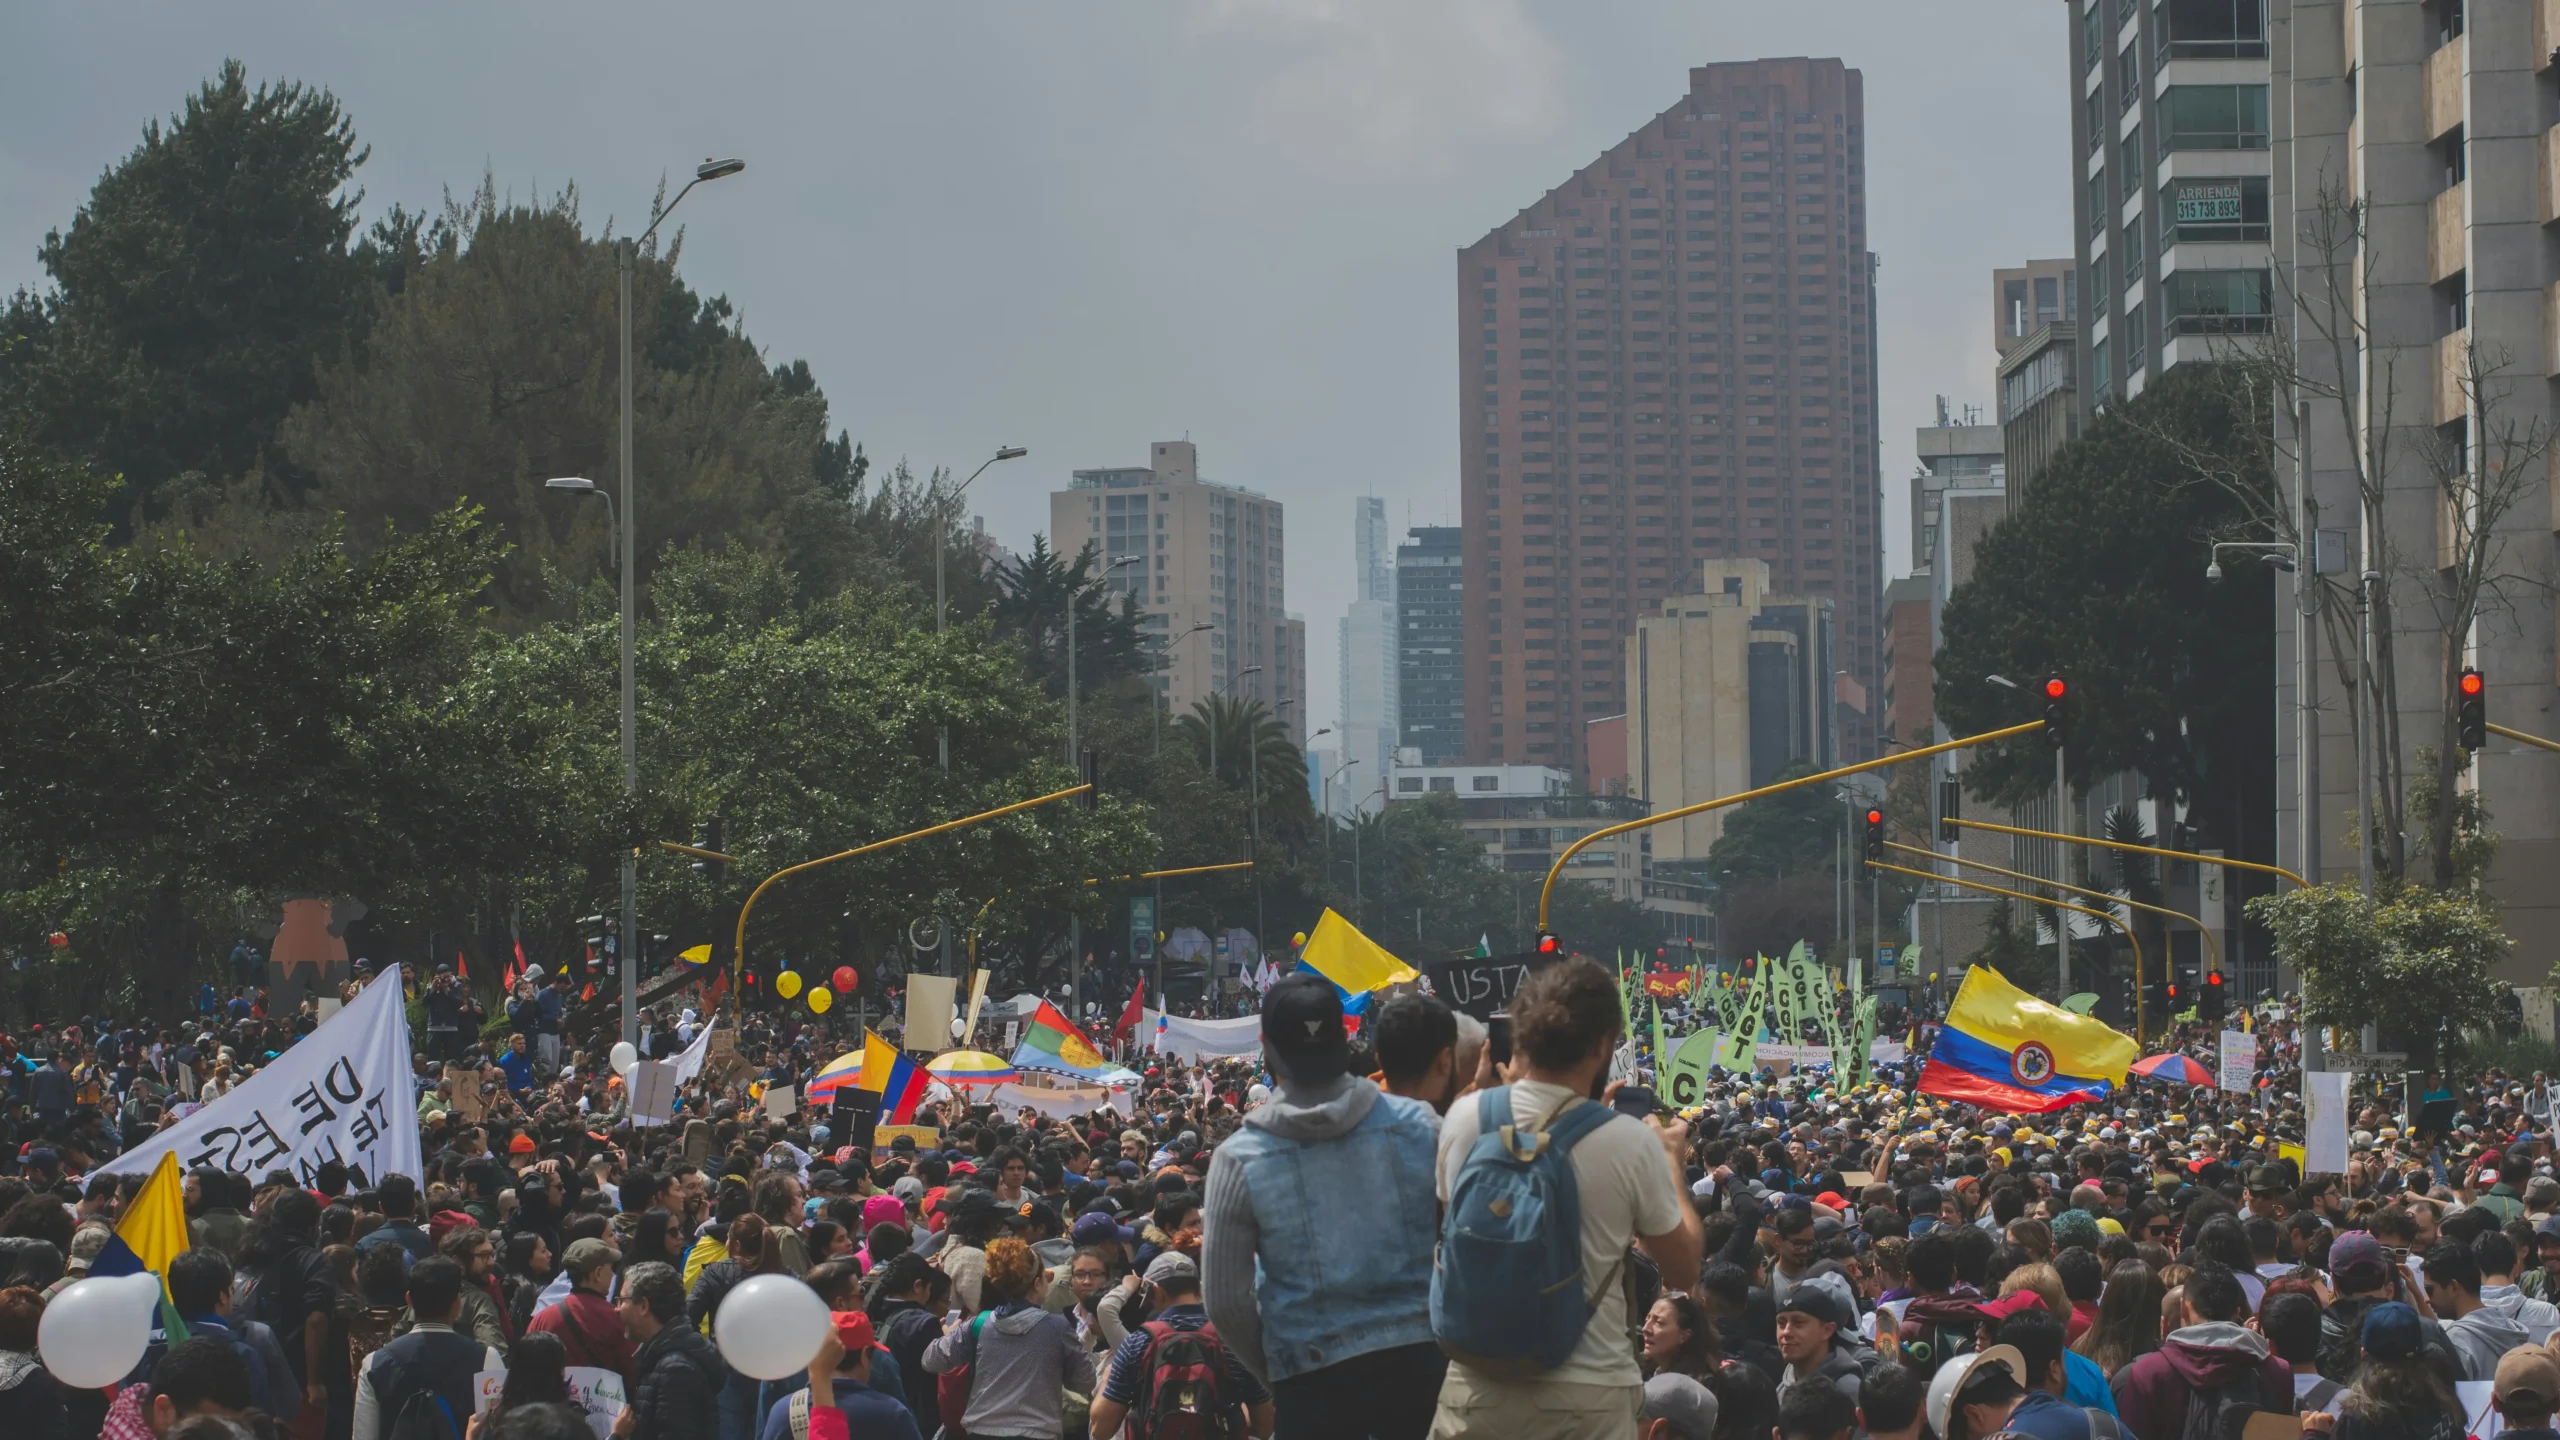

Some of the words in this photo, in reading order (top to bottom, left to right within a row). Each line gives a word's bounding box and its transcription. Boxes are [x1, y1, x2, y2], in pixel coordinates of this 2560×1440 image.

[2178, 186, 2240, 200] ARRIENDA
[2178, 202, 2196, 218] 315
[2198, 201, 2216, 218] 738
[1791, 964, 1808, 1011] CGT
[1733, 990, 1763, 1060] CGT
[2349, 1058, 2403, 1068] ARZOBISP
